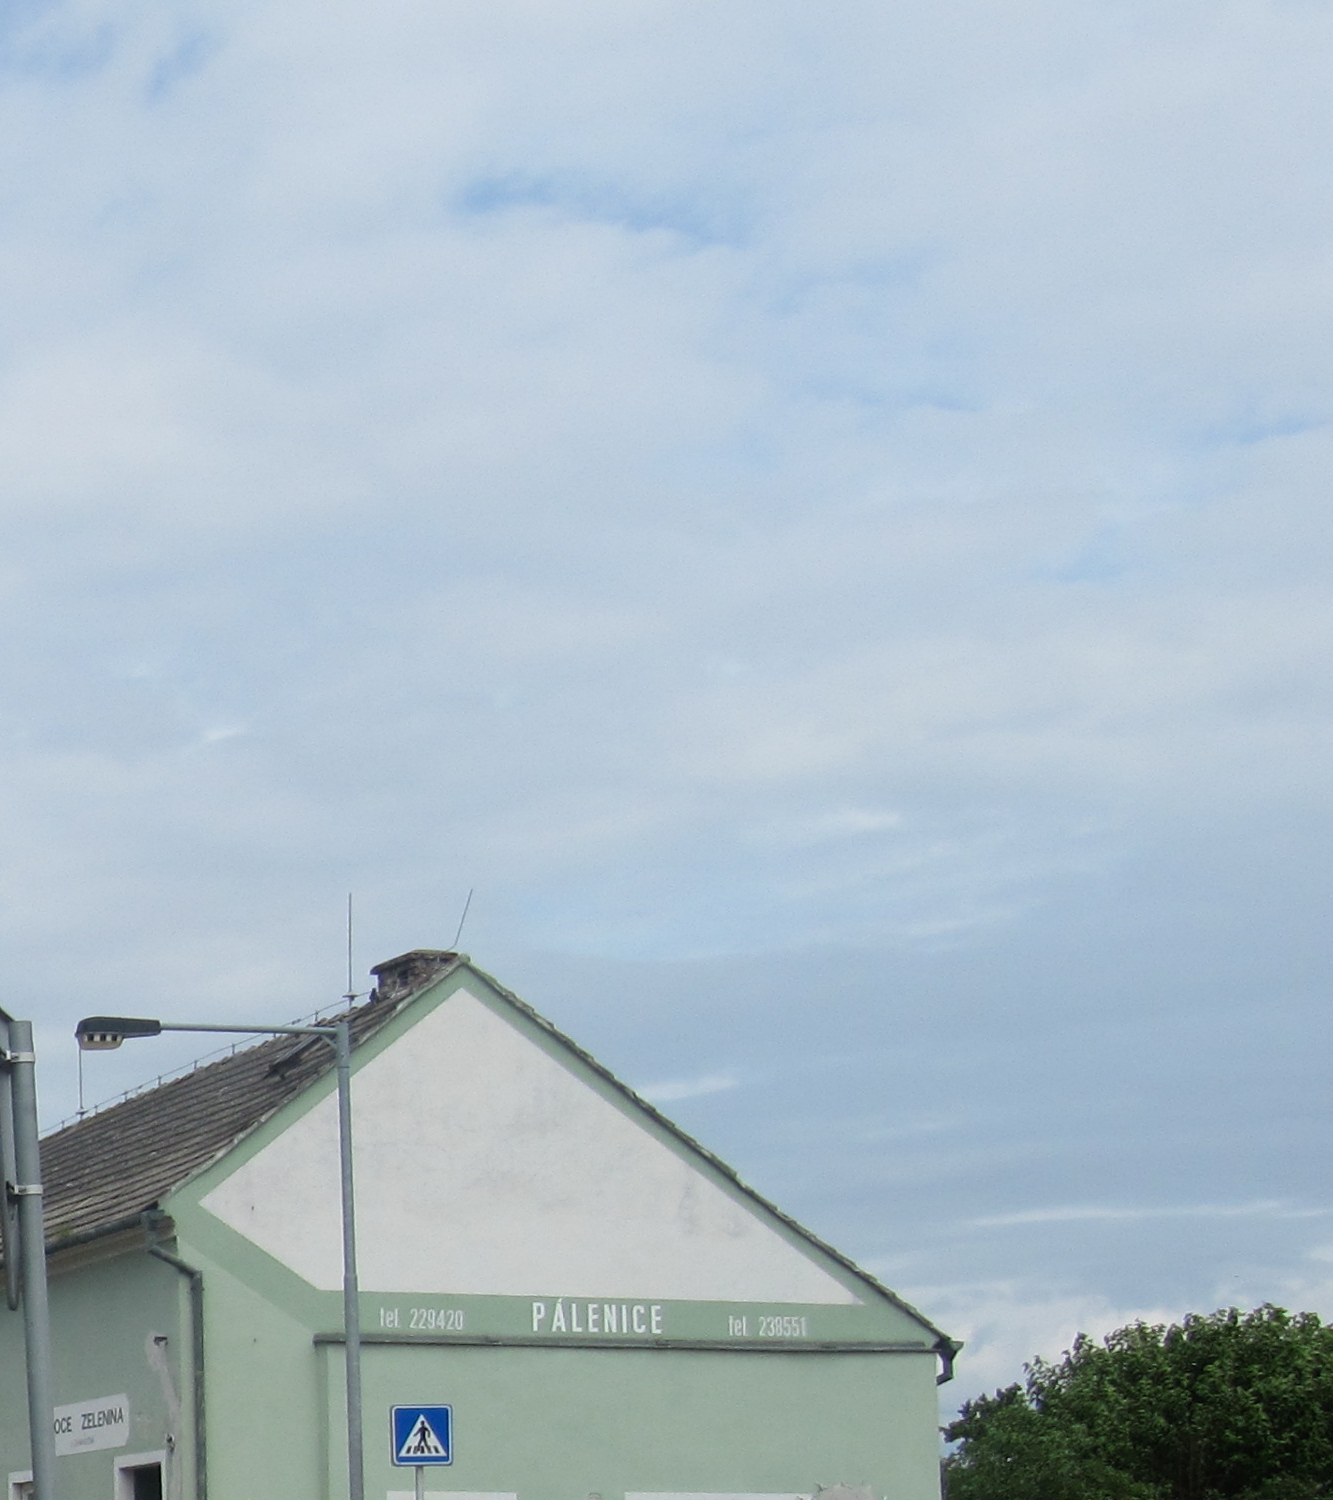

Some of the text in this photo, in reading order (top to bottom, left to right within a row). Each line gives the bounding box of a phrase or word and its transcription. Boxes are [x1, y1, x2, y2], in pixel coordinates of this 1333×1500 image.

[409, 1308, 464, 1330] 229420
[532, 1298, 663, 1334] PÁLENICE
[758, 1316, 807, 1337] 238551
[53, 1416, 73, 1434] OCE
